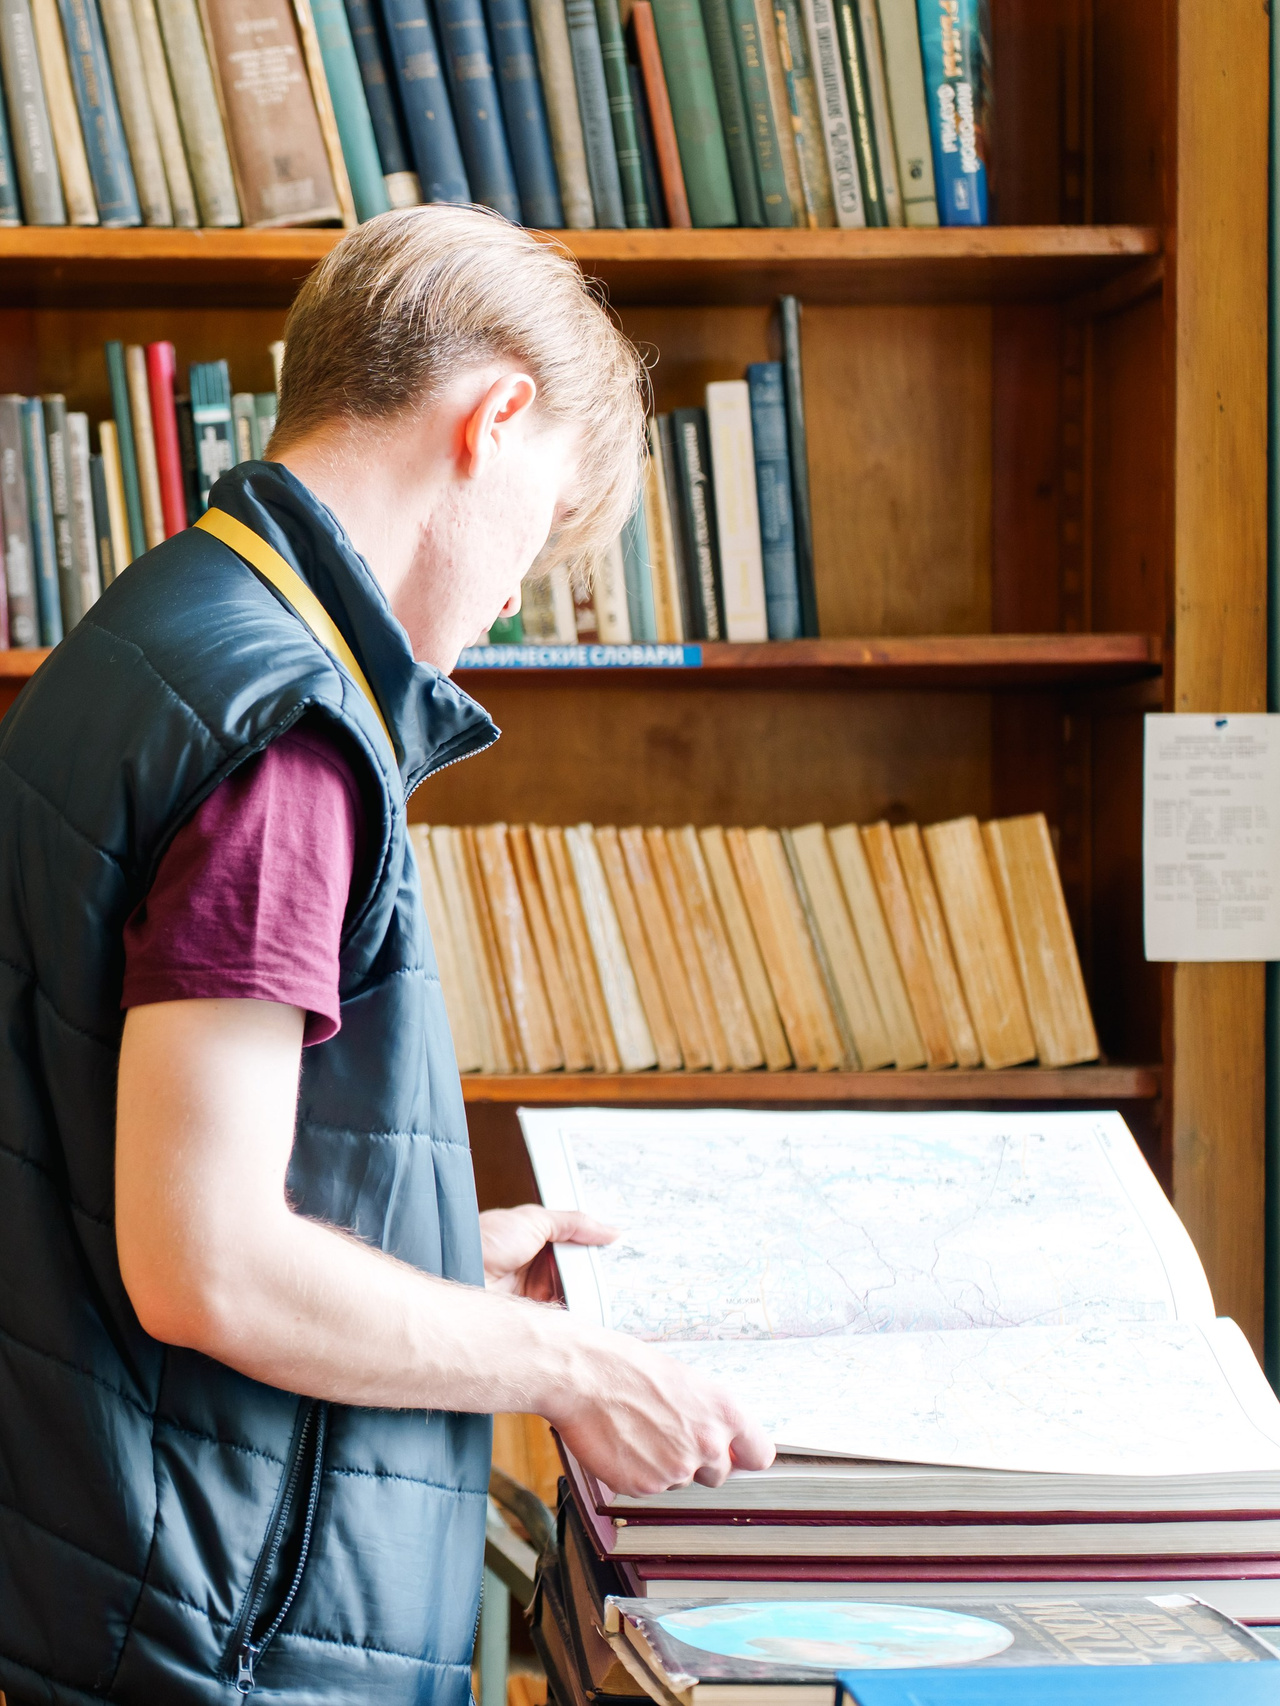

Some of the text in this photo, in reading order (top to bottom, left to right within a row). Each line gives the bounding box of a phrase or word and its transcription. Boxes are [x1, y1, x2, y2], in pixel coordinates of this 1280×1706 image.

[956, 82, 980, 174] МИРОВОЙ
[831, 123, 858, 213] СЛОВАРЬ
[590, 646, 684, 666] СЛОВАРИ
[1014, 1600, 1153, 1666] WORLD
[1092, 1610, 1212, 1654] ATLAS
